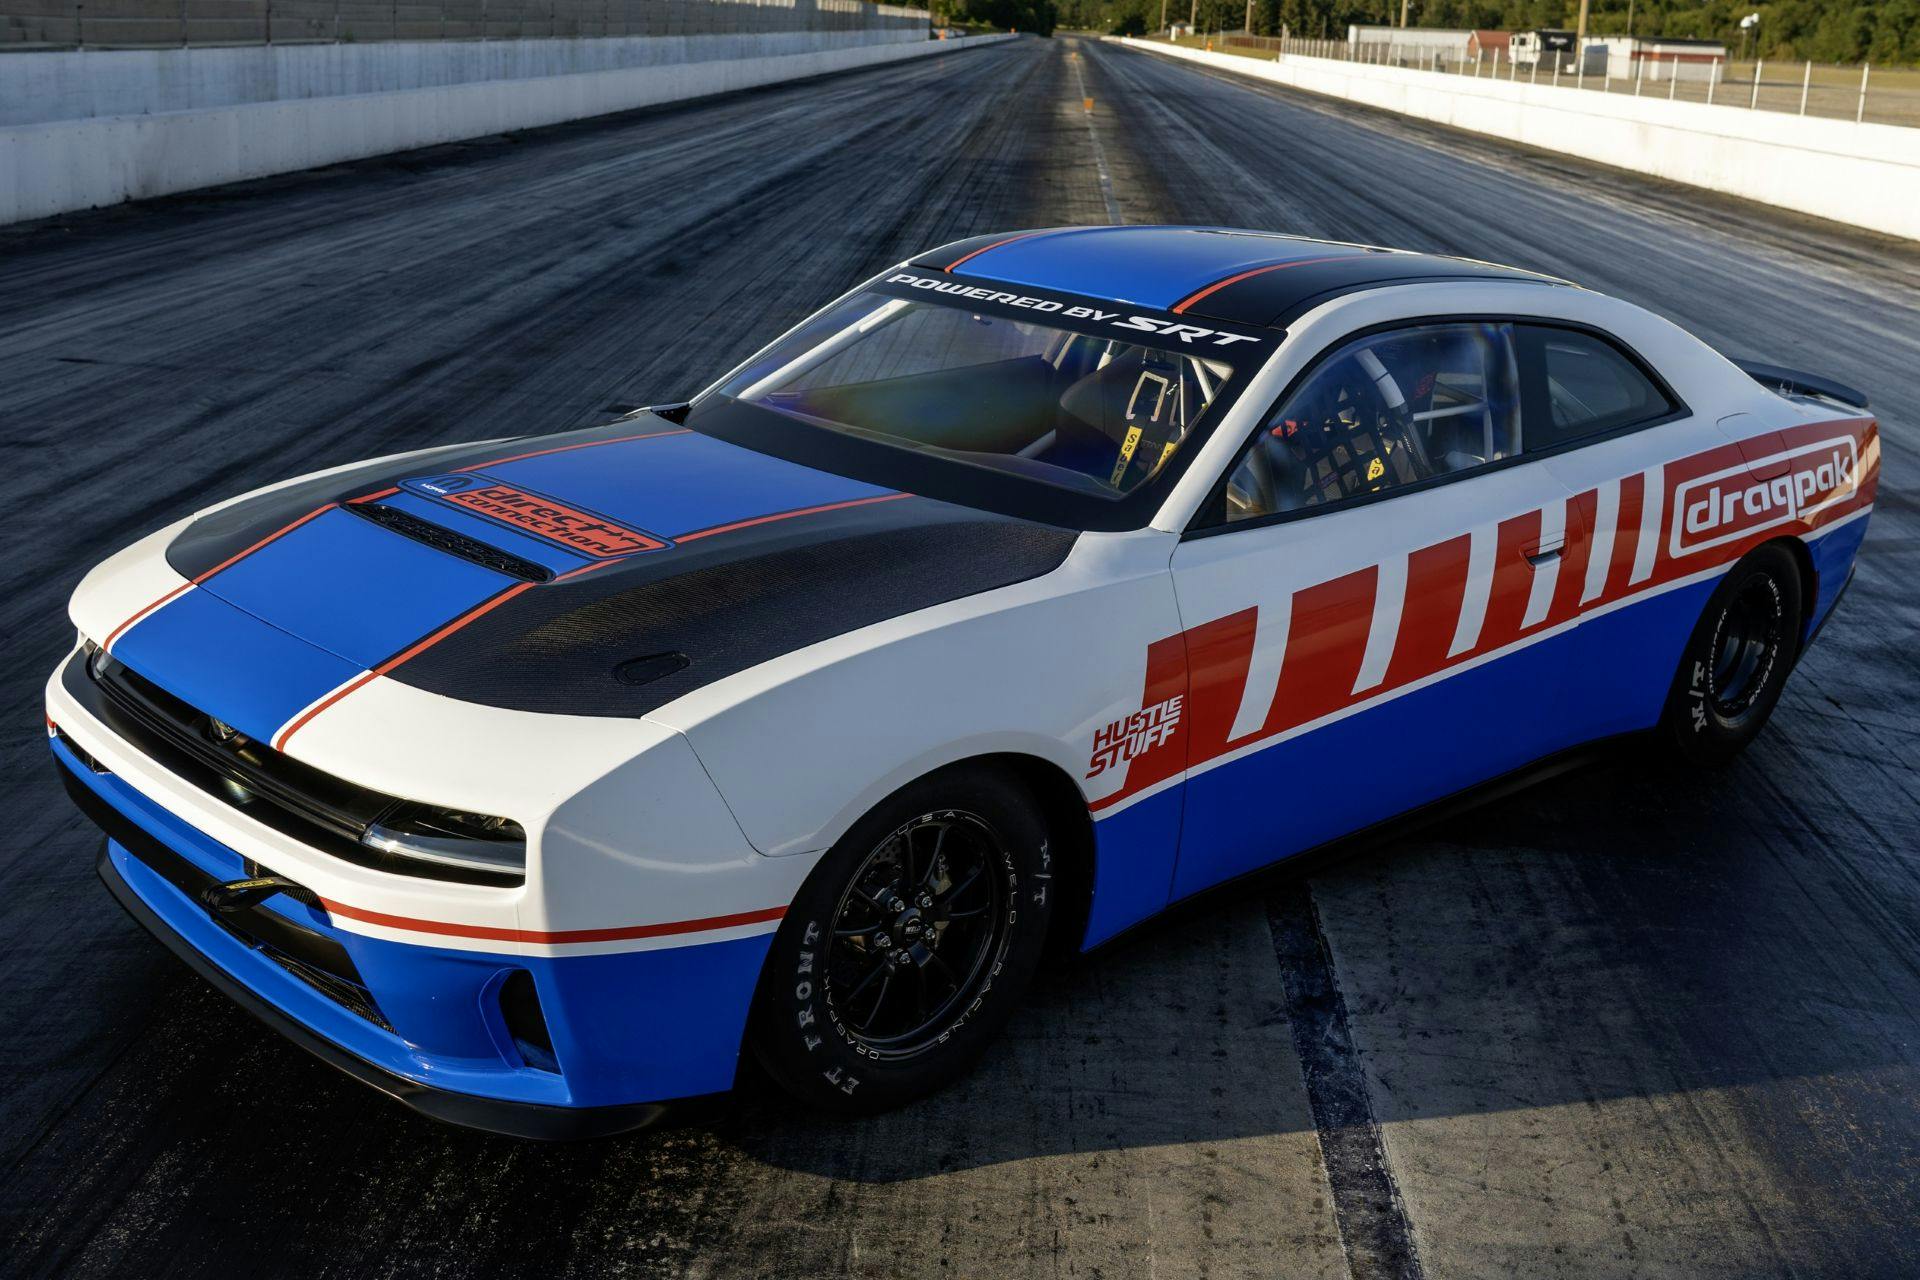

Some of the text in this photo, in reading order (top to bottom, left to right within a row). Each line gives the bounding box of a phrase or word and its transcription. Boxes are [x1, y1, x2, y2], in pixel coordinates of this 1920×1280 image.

[885, 272, 1262, 347] POWERED BY SRT
[454, 493, 612, 553] connection
[477, 487, 612, 534] direct
[1686, 450, 1852, 534] dragpak
[1085, 716, 1180, 780] STUFF
[1092, 694, 1184, 753] HUSTLE
[938, 851, 1018, 1044] WELD RACING
[796, 920, 861, 1096] ET FRONT
